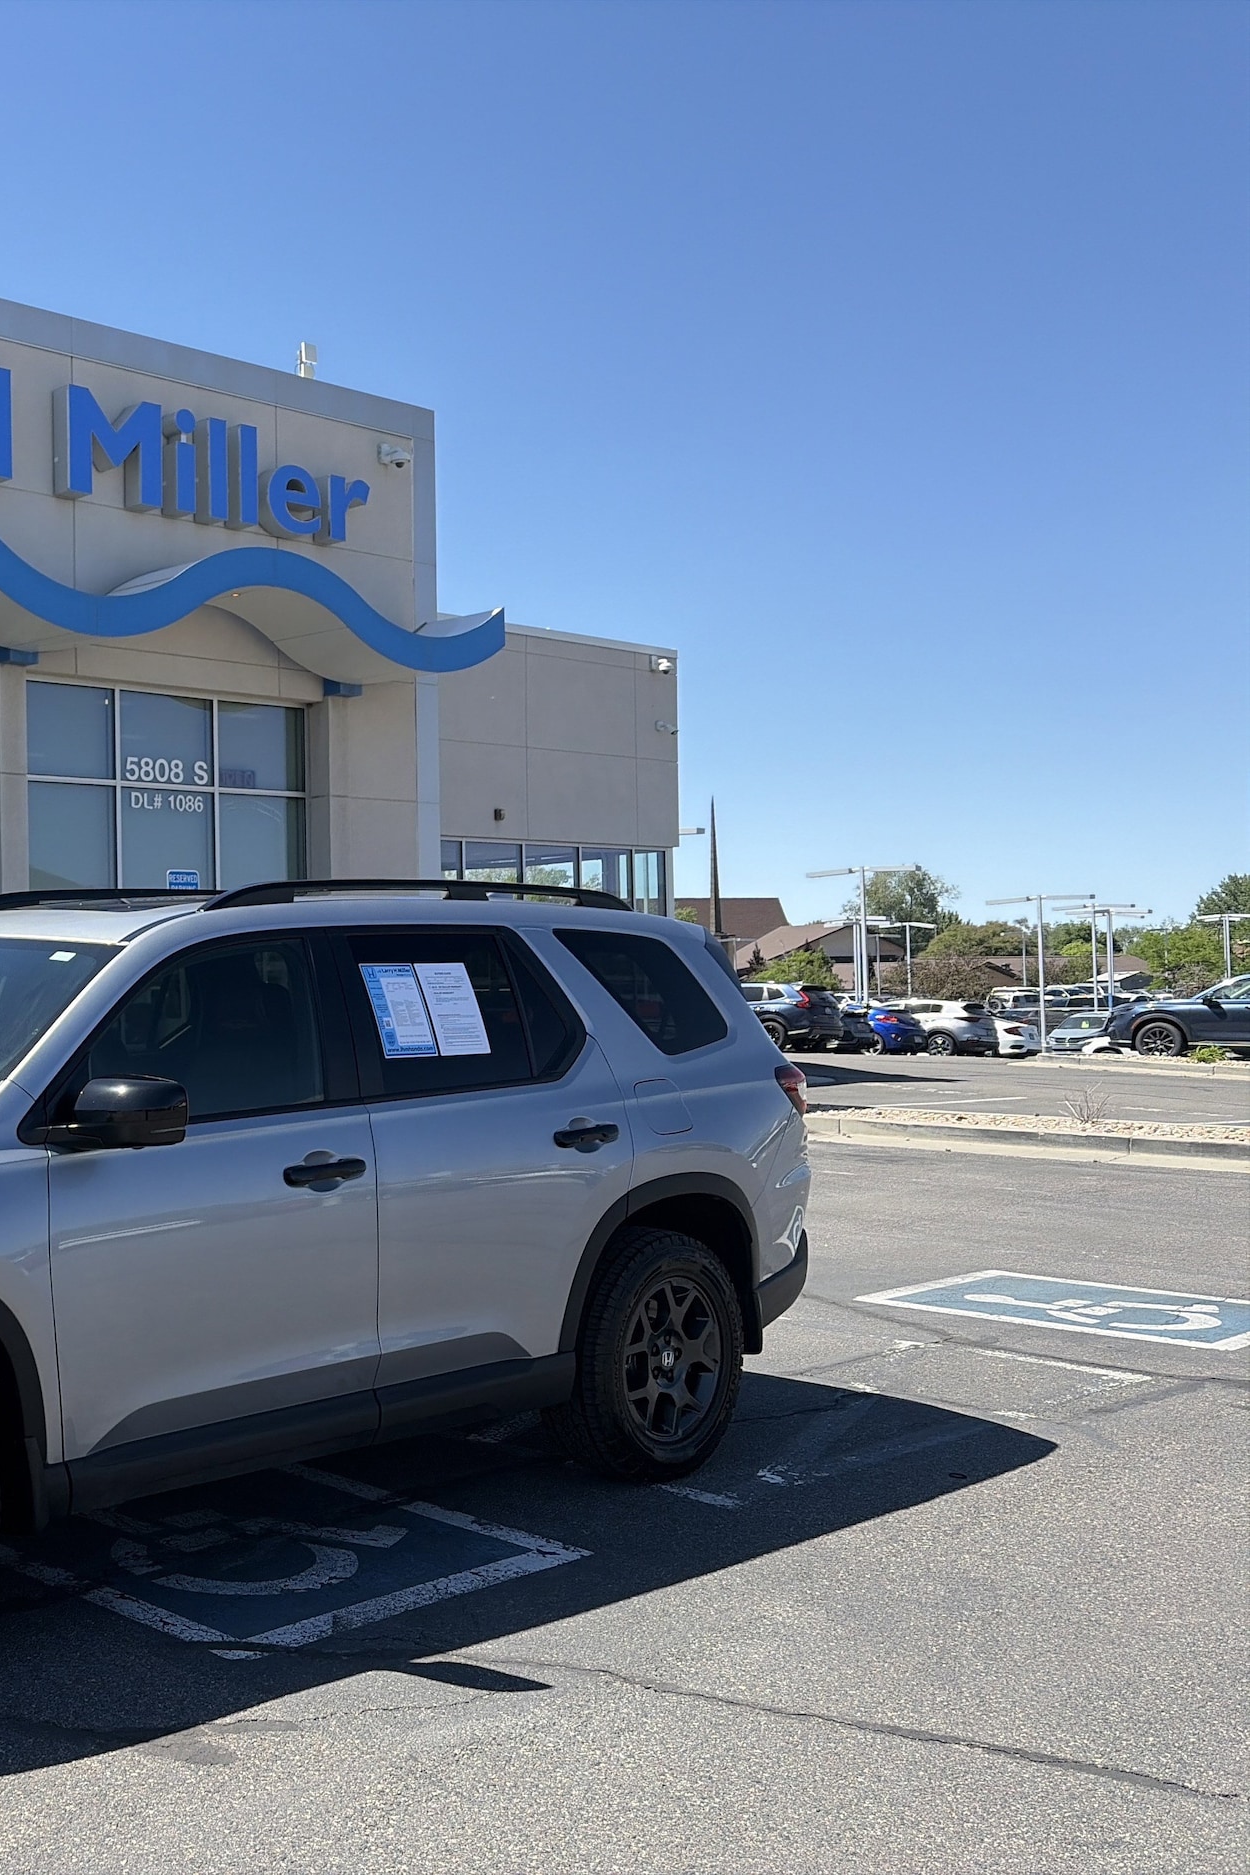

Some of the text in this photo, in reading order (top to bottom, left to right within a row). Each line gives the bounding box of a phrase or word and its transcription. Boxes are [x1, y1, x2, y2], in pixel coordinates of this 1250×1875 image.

[53, 384, 370, 545] Miller
[125, 756, 209, 785] 5808 S
[131, 792, 204, 812] DL# 1086
[168, 874, 198, 883] RESERVED
